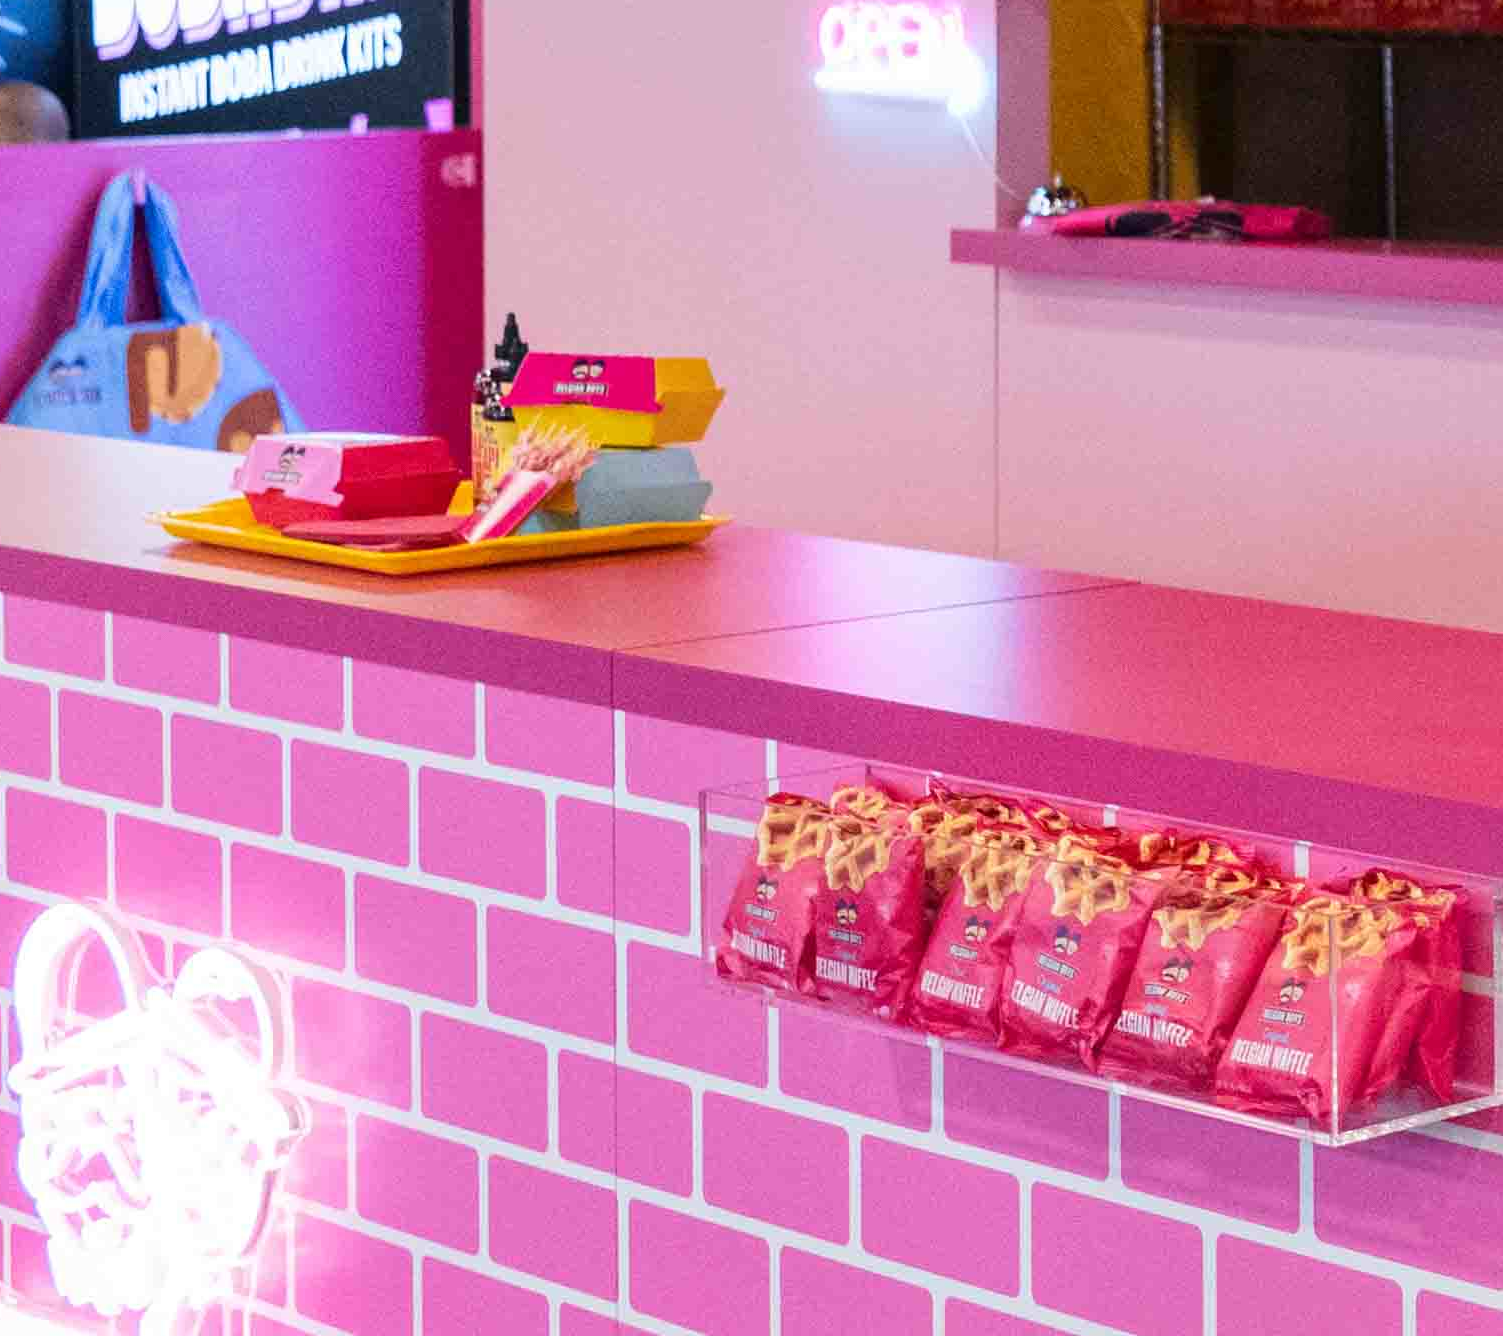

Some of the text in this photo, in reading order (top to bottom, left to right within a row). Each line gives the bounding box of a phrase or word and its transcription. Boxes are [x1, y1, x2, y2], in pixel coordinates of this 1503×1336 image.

[118, 12, 404, 125] INSTANT BOBA DRINK KITS
[1011, 979, 1046, 1014] ELGIAN
[1152, 1016, 1194, 1048] WAFFLE
[1231, 1039, 1313, 1075] BELGIAN WAFFLE
